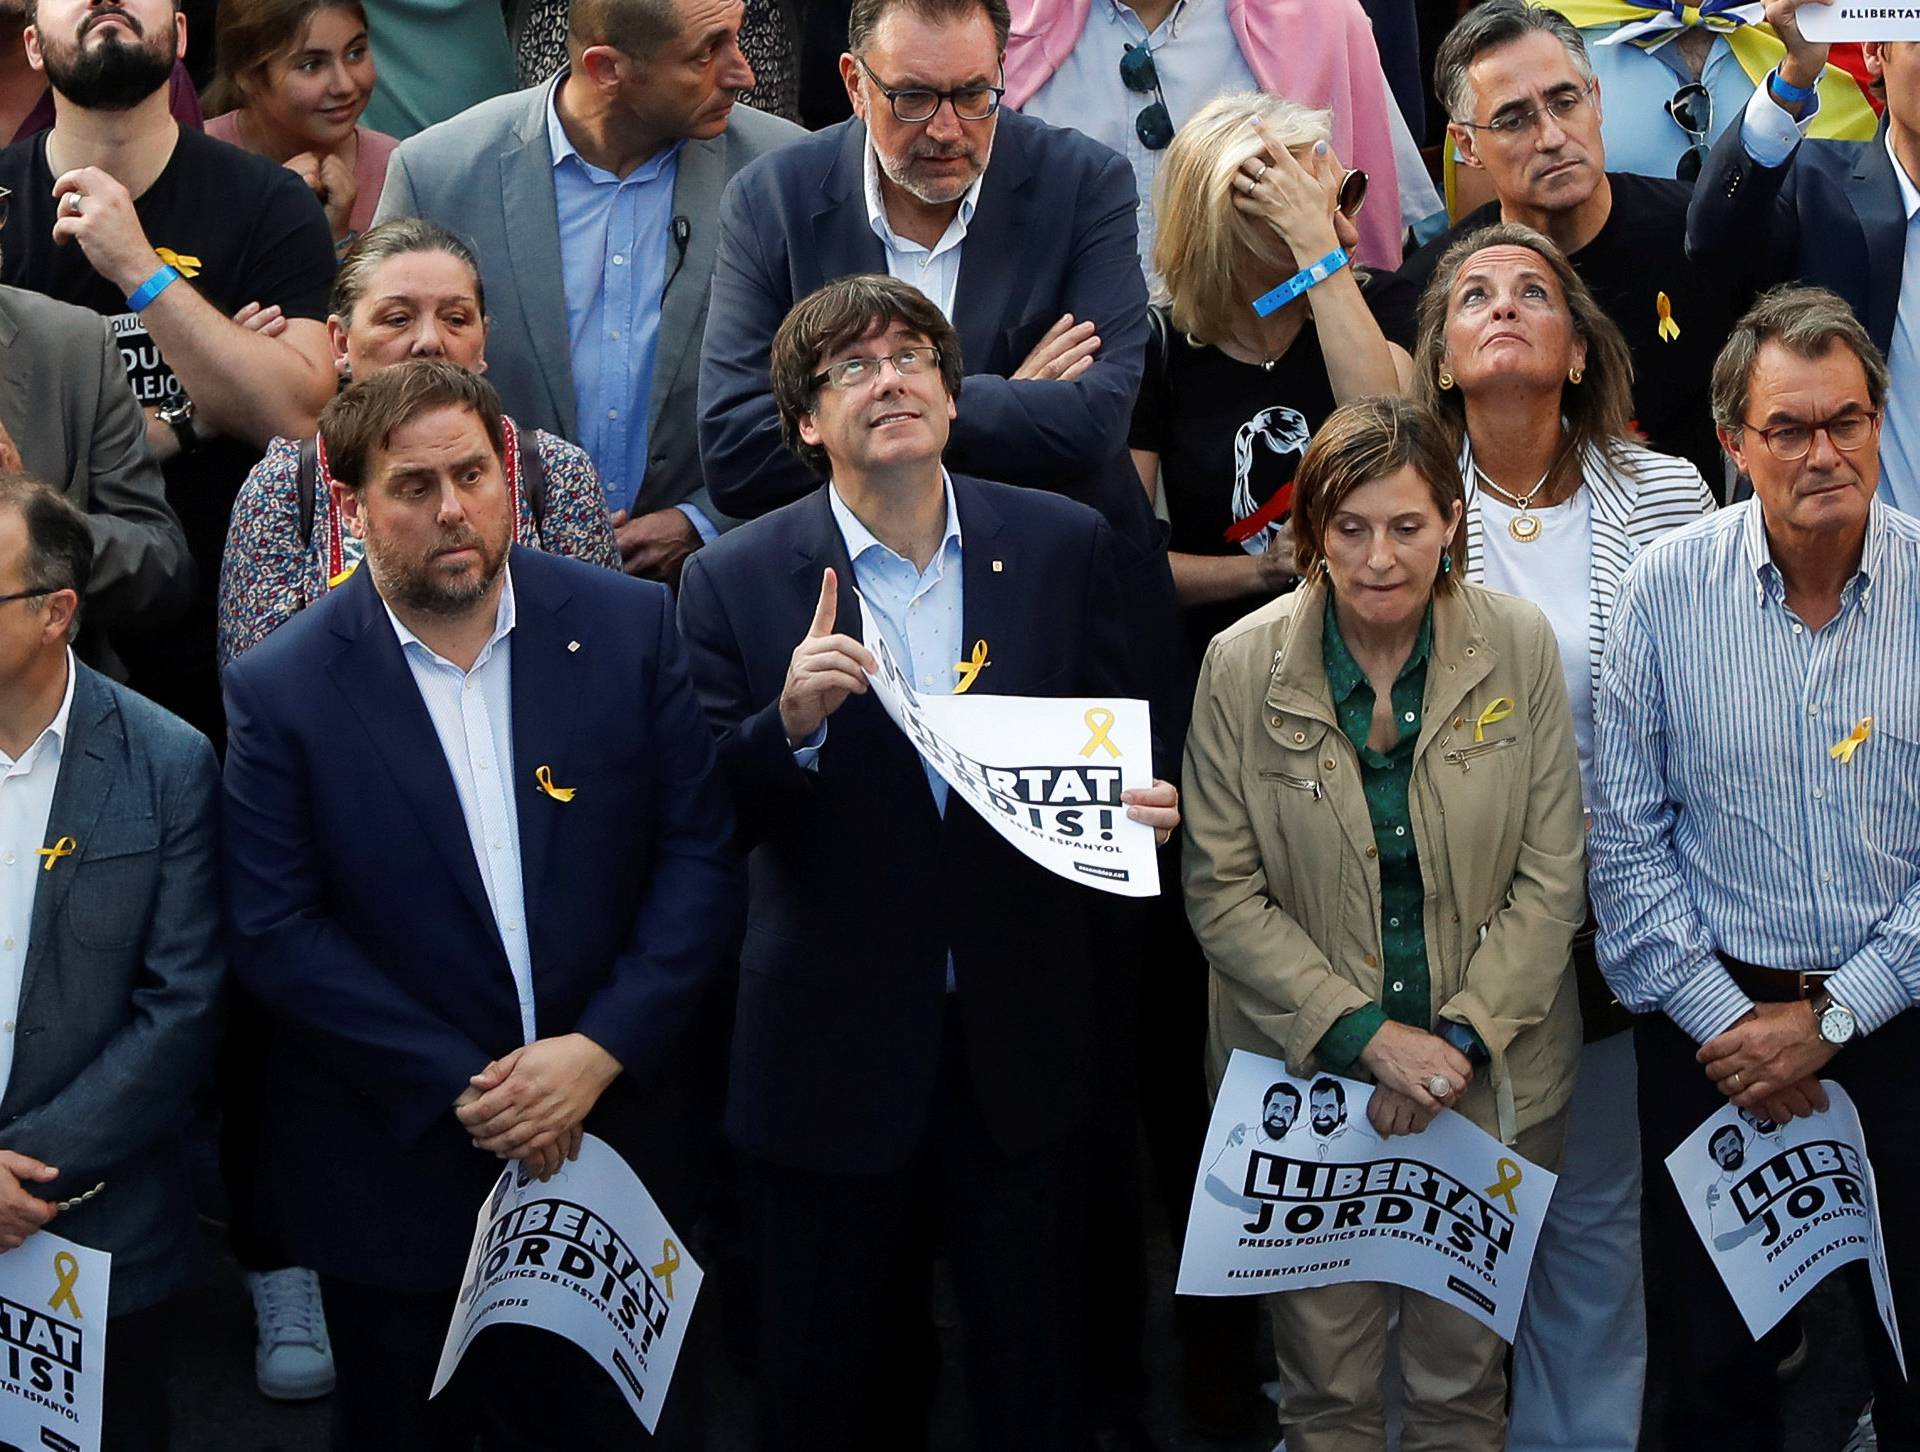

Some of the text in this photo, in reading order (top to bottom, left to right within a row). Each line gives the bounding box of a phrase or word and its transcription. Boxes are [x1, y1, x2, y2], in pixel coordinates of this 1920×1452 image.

[1049, 836, 1123, 853] ESPANYOL
[1253, 1157, 1510, 1239] LLIBERTAT
[1737, 1145, 1863, 1215] LLIBE
[1761, 1178, 1865, 1246] JOR
[1238, 1228, 1498, 1288] PRESOS POLÍTICS DE L'ESTAT ESPANYOL
[1243, 1196, 1498, 1271] JORDIS!
[1766, 1206, 1867, 1263] PRESOS POLÍTIC
[1779, 1236, 1867, 1293] #LLIBERTATJOR
[483, 1237, 653, 1354] ORDIS!
[1227, 1258, 1351, 1278] #LLIBERTATJORDIS
[541, 1271, 560, 1283] DE
[562, 1278, 607, 1312] L'ESTAT
[607, 1311, 648, 1373] ESPANYOL
[23, 1389, 79, 1423] ESPANYOL
